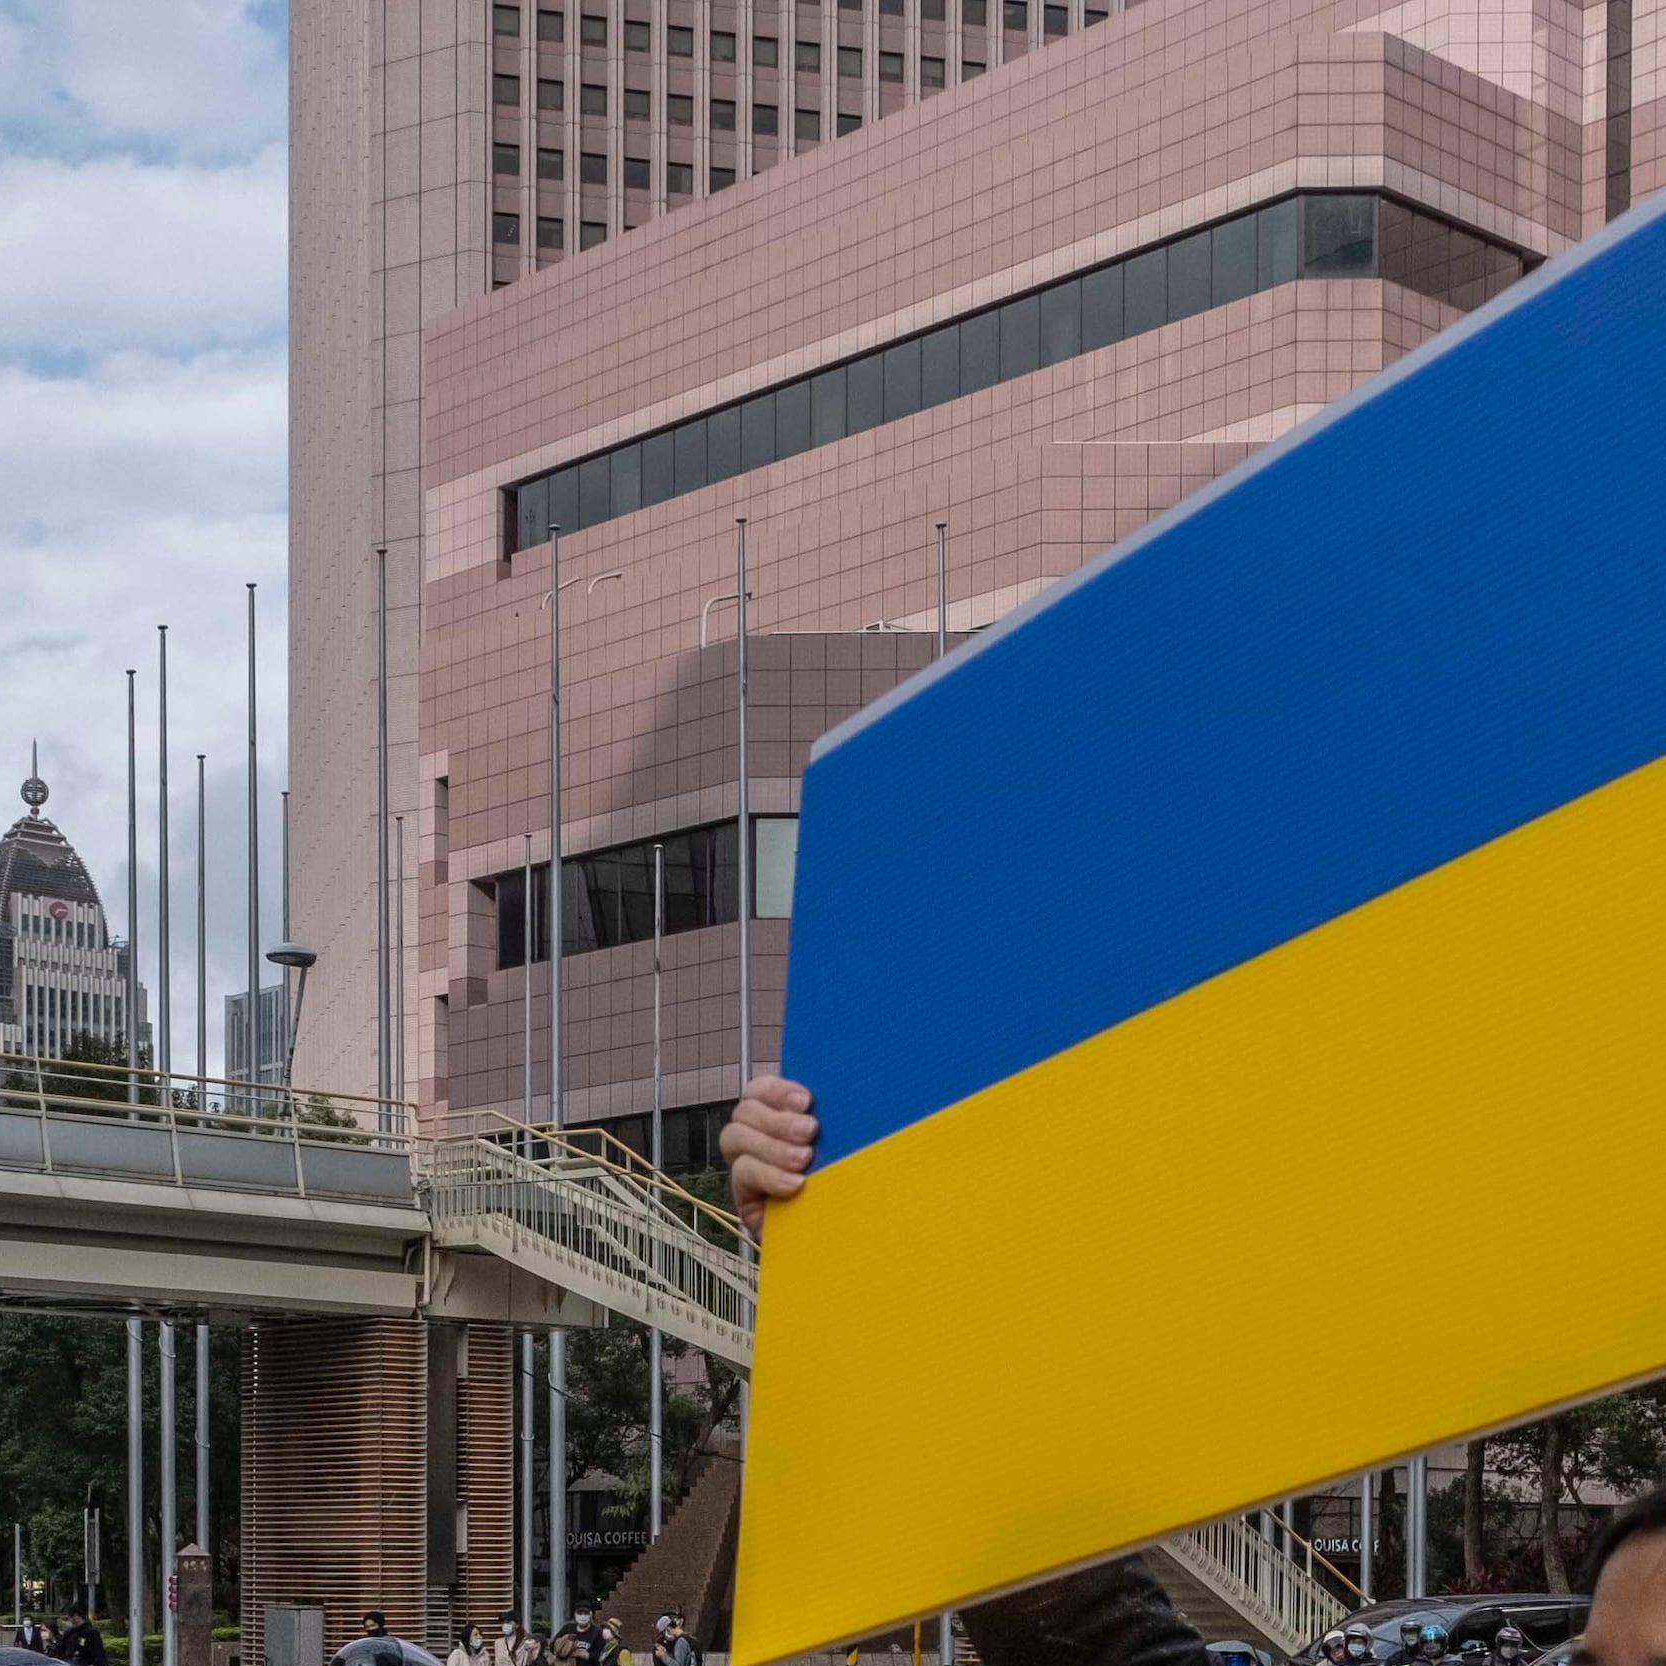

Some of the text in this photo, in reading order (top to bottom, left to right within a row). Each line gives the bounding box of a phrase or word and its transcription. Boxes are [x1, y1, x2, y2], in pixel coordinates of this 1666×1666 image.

[566, 1531, 648, 1546] OUISA COFFEE
[1314, 1538, 1349, 1552] OUISA
